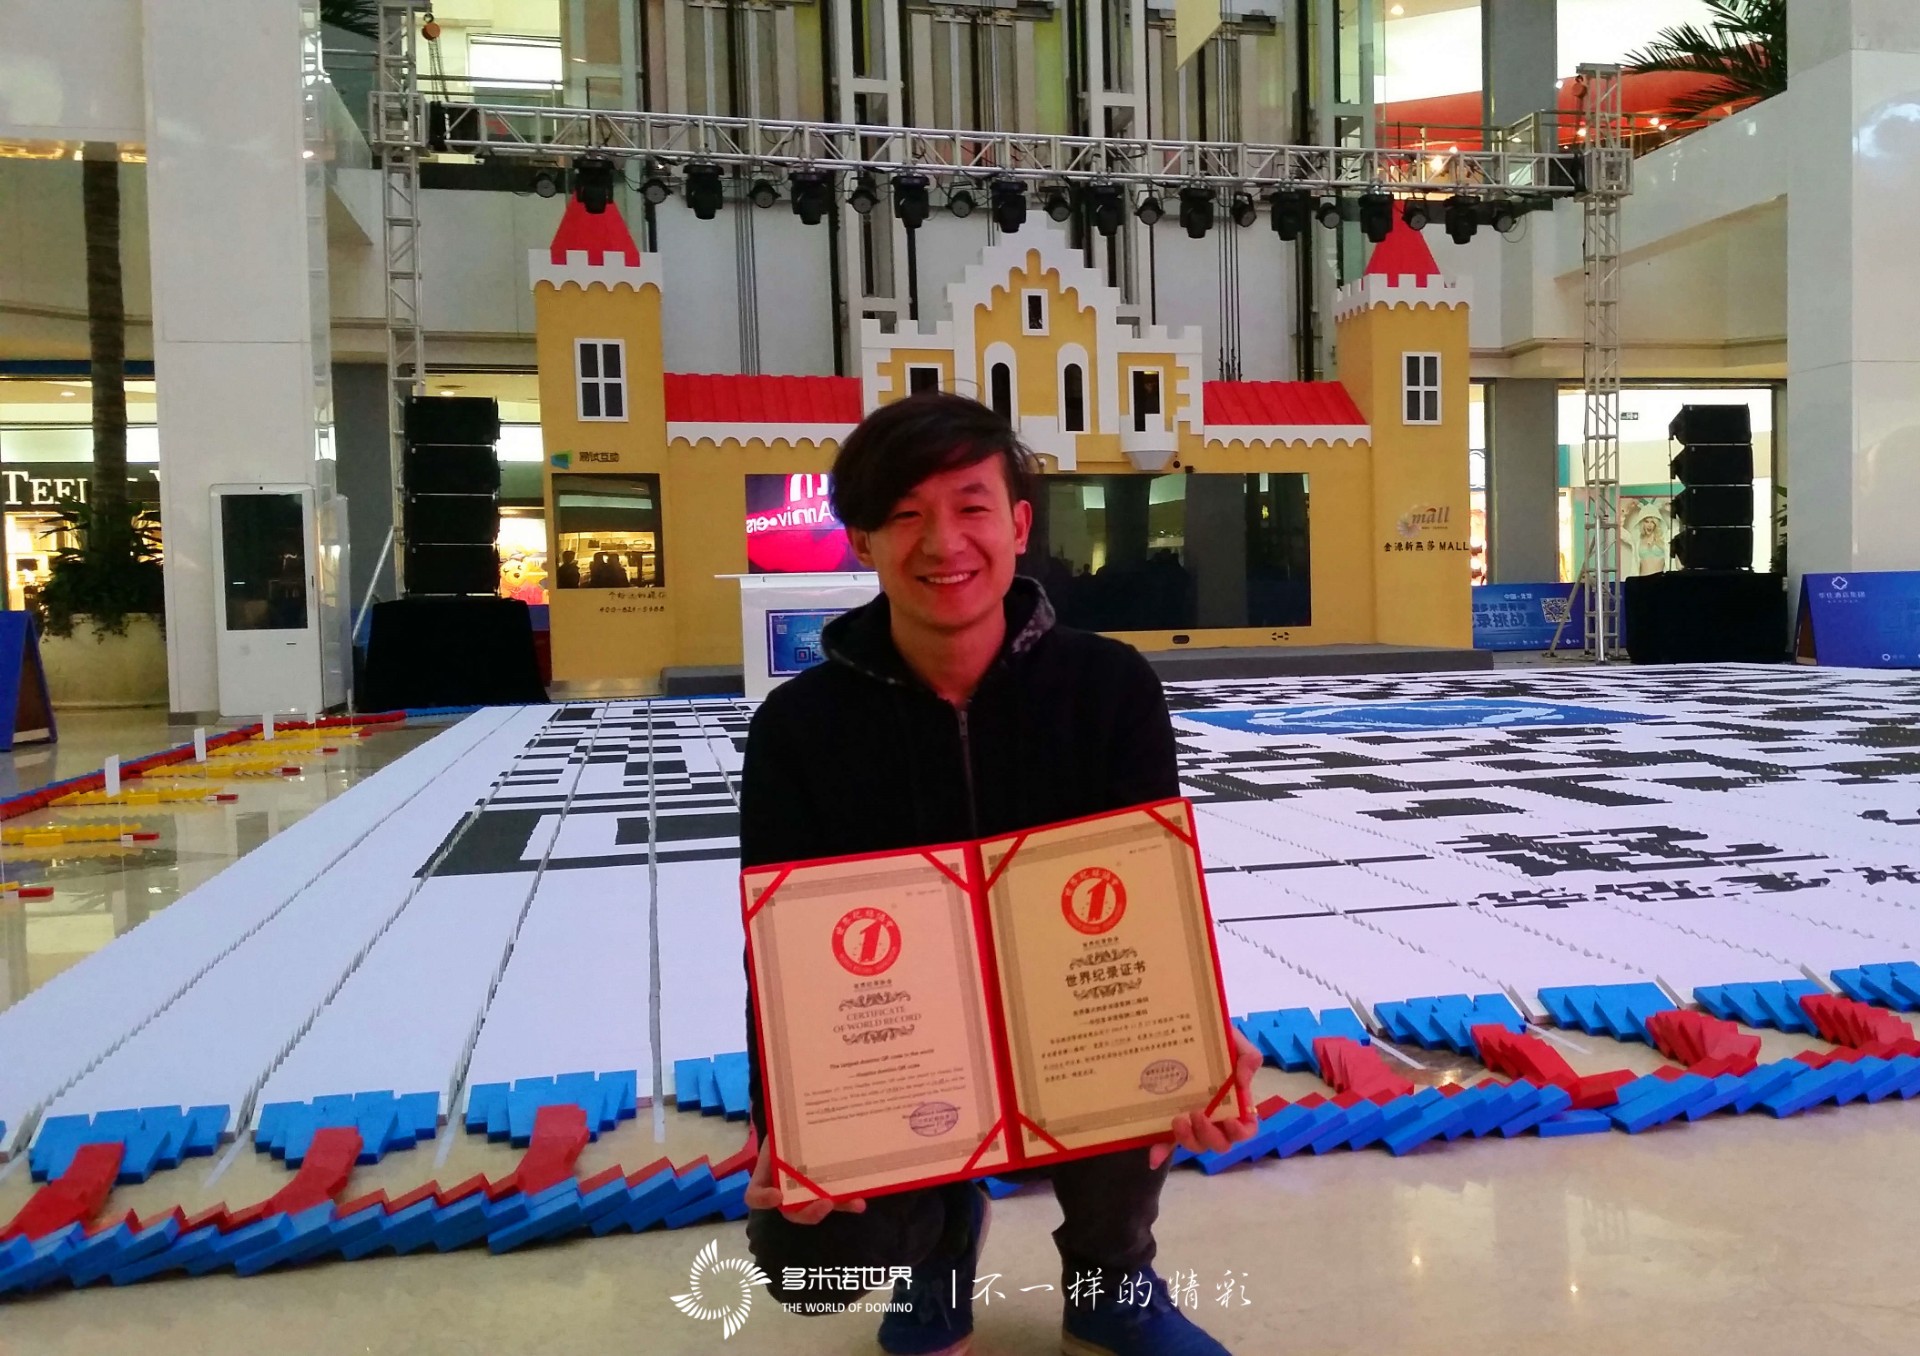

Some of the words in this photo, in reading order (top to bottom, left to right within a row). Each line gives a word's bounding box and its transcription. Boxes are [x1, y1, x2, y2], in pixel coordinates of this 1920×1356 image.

[1411, 506, 1450, 525] mall
[1439, 541, 1470, 551] MALL
[1472, 612, 1528, 628] 录挑战
[1065, 960, 1146, 988] 世界纪录证书
[846, 1006, 905, 1021] CERTIFICATE
[833, 1024, 844, 1033] OF
[847, 1018, 882, 1030] WORLD
[883, 1013, 922, 1023] RECORD
